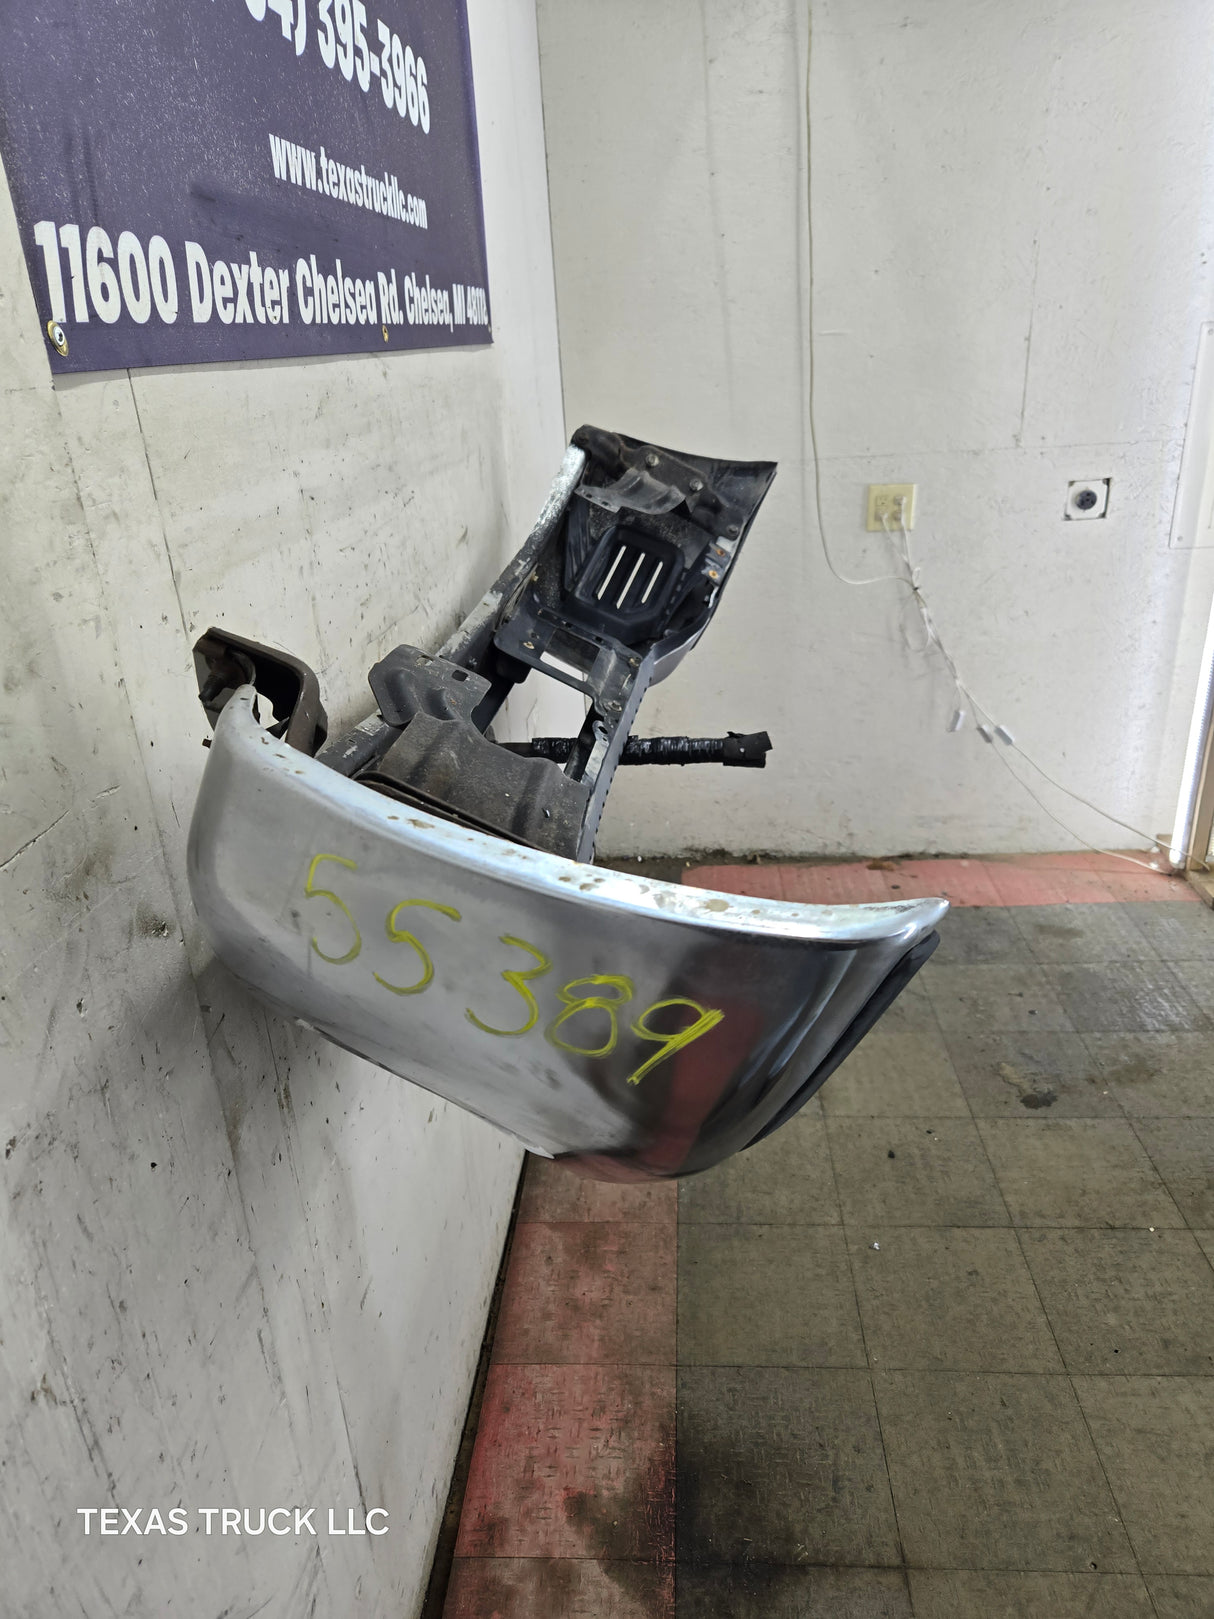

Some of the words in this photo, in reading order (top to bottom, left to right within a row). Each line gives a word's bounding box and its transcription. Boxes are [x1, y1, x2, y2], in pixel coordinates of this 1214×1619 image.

[317, 0, 430, 134] 395-3966
[269, 133, 428, 229] www.texastruckllc.com
[33, 220, 177, 324] 11600
[184, 241, 290, 325] Dexter
[296, 254, 378, 325] Chelsea
[377, 268, 404, 325] Rd.
[404, 272, 454, 333] Chelsea,
[452, 283, 466, 325] MI
[305, 854, 725, 1085] 55389
